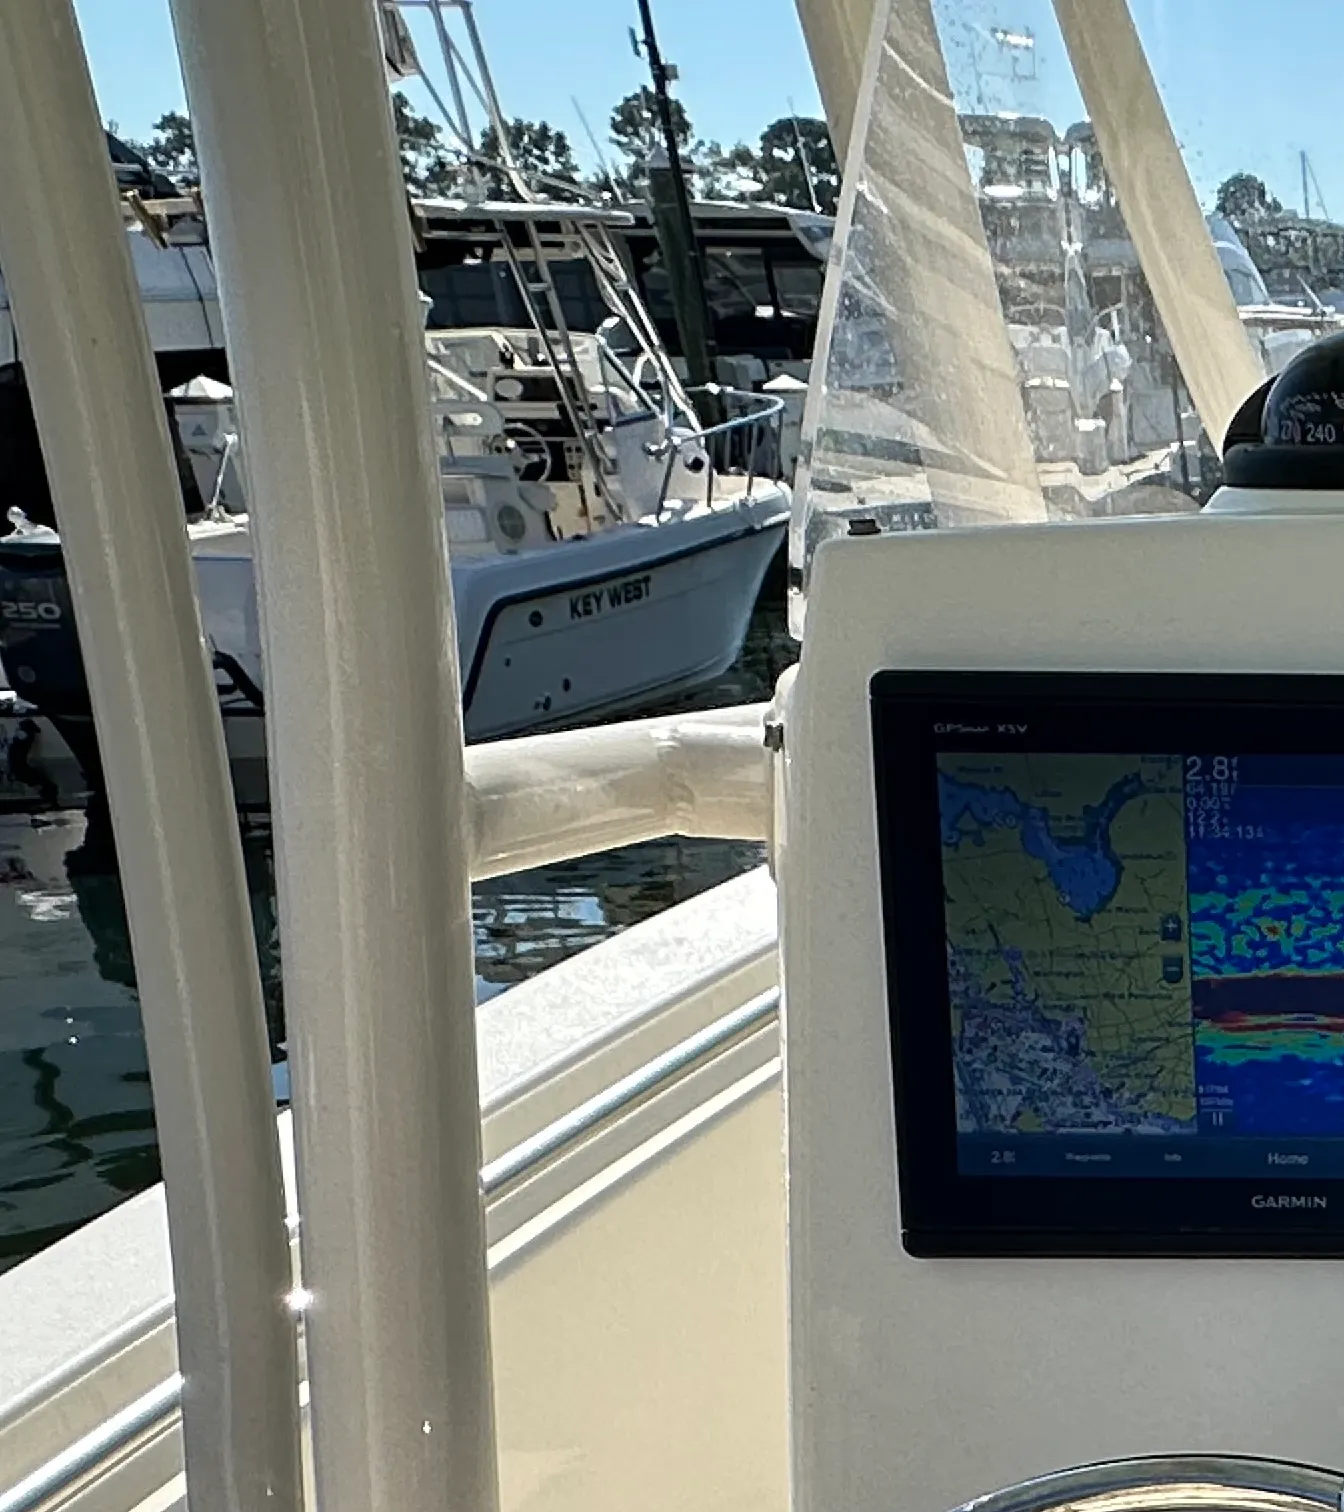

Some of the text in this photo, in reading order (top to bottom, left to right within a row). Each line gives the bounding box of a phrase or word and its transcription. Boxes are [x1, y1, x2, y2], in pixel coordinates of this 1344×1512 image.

[1306, 425, 1335, 442] 240
[569, 575, 652, 620] KEY WEST
[1, 600, 62, 620] 250
[1267, 1152, 1310, 1166] Home
[1250, 1194, 1328, 1210] GARMIN
